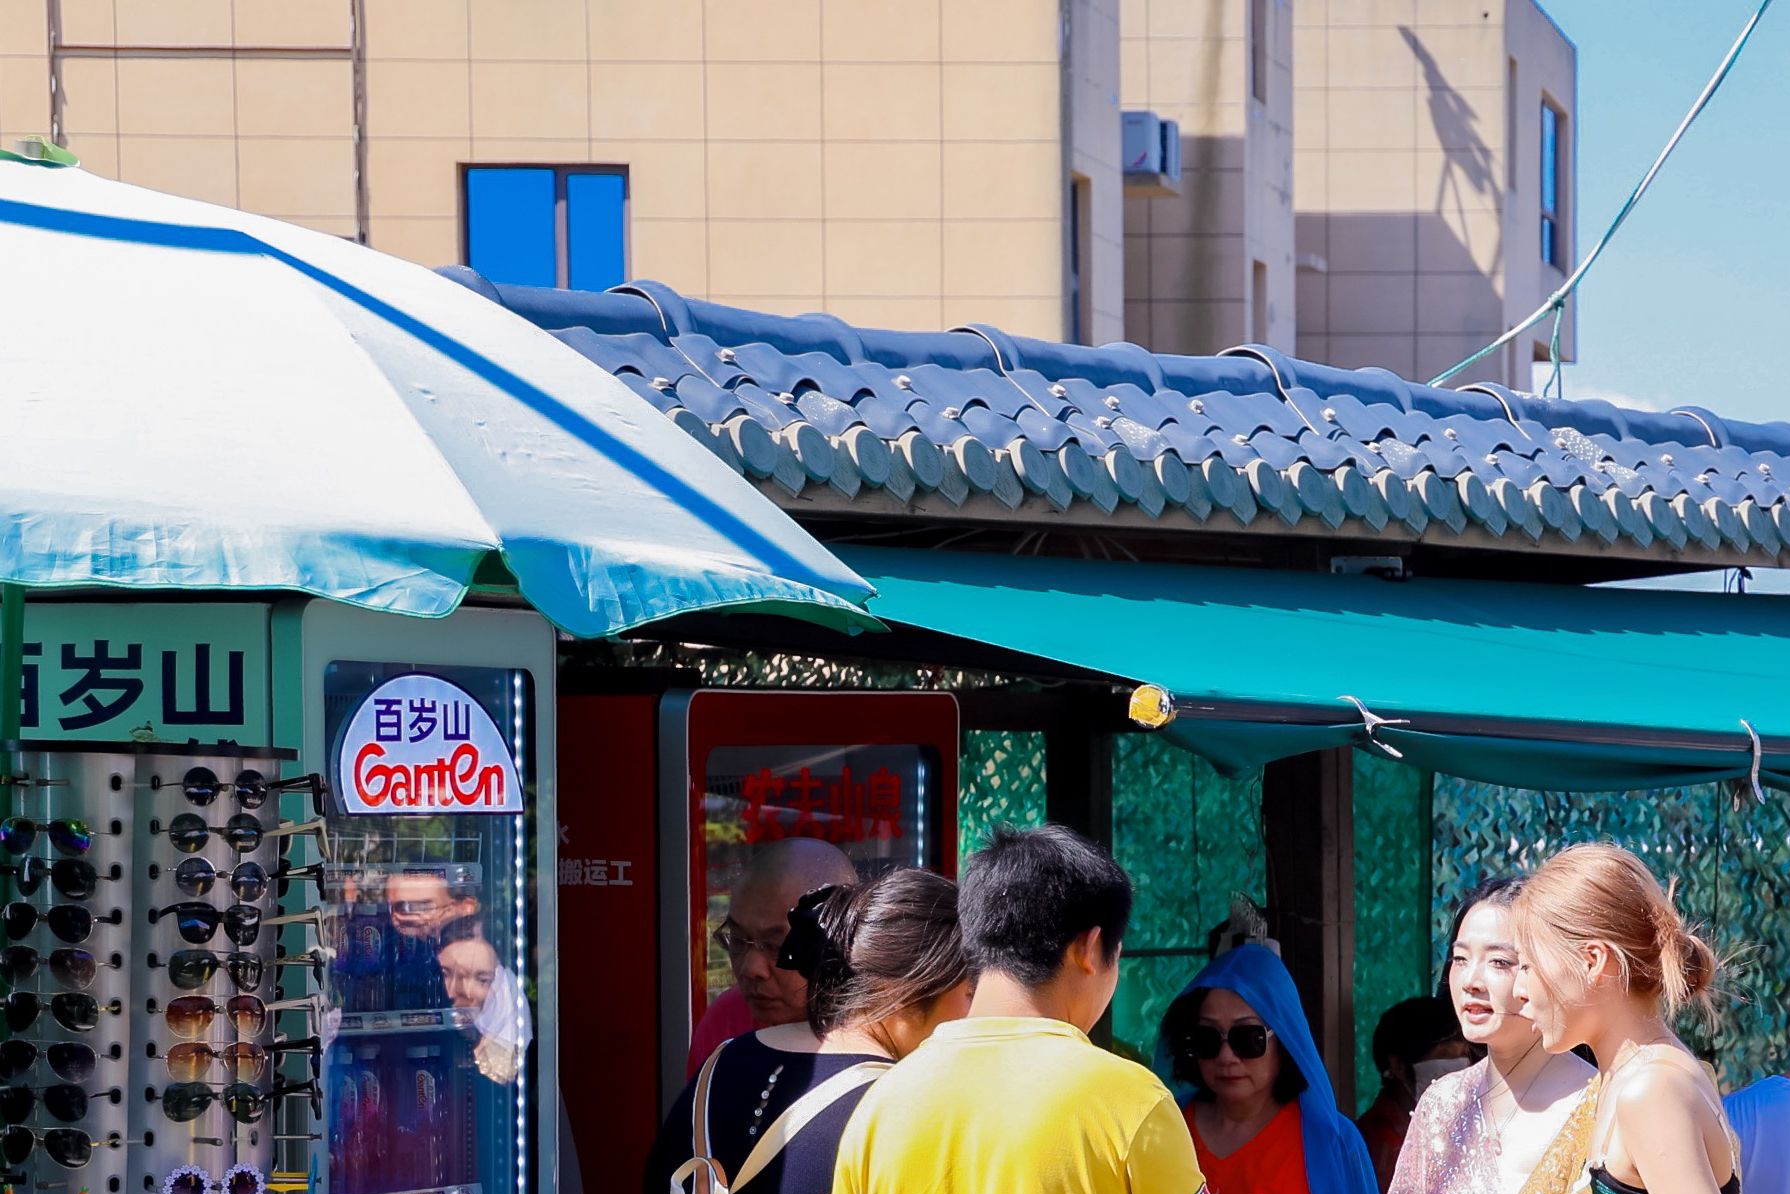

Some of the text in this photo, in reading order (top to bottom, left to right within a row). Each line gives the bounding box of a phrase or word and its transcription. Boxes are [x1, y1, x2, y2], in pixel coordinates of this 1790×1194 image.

[374, 697, 471, 743] 百岁山
[742, 766, 903, 844] 农夫山泉
